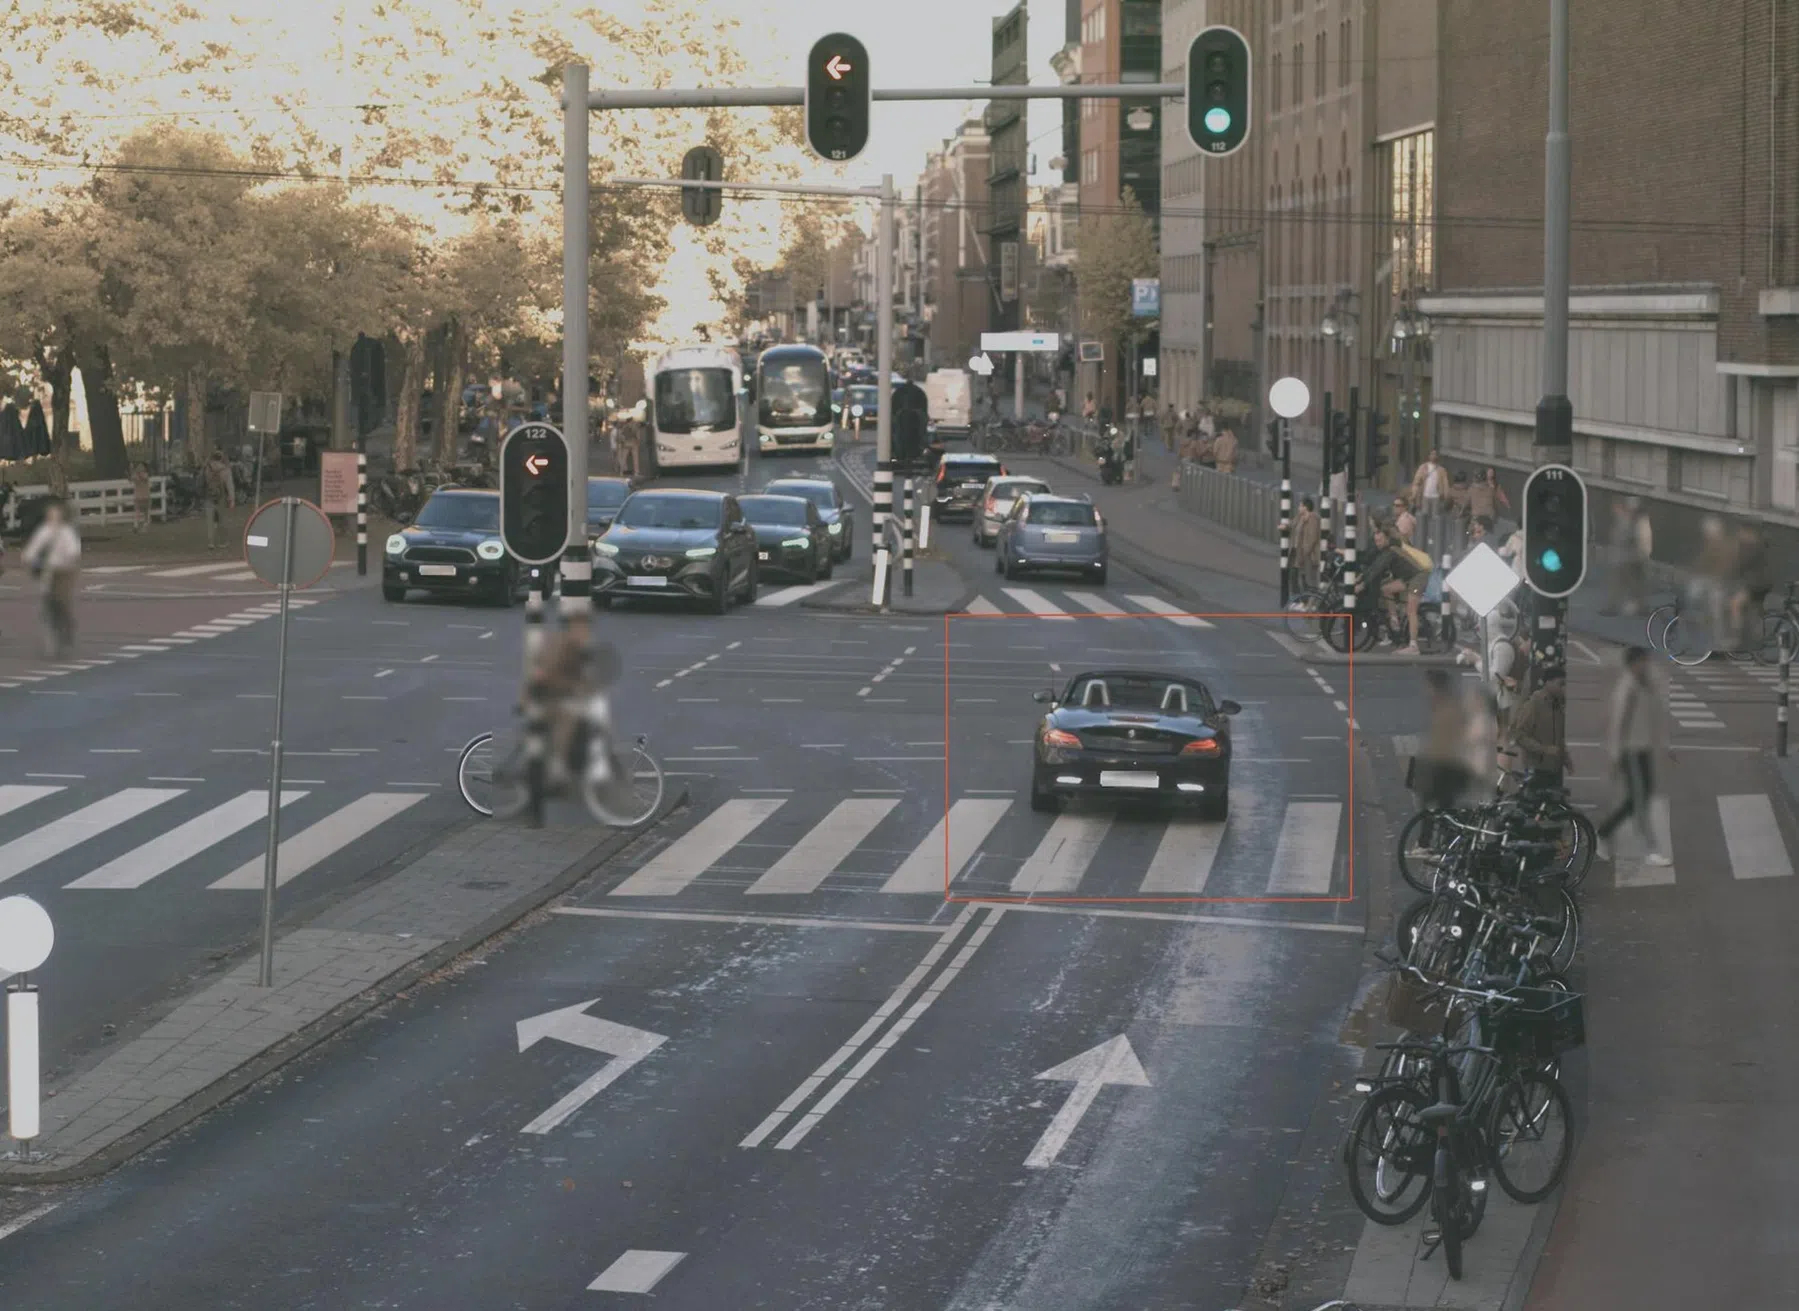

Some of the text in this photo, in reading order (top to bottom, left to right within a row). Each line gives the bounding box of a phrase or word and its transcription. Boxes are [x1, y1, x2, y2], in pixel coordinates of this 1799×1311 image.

[1211, 141, 1226, 150] 112
[831, 150, 846, 159] 121
[525, 428, 547, 439] 122
[1545, 470, 1562, 480] 111
